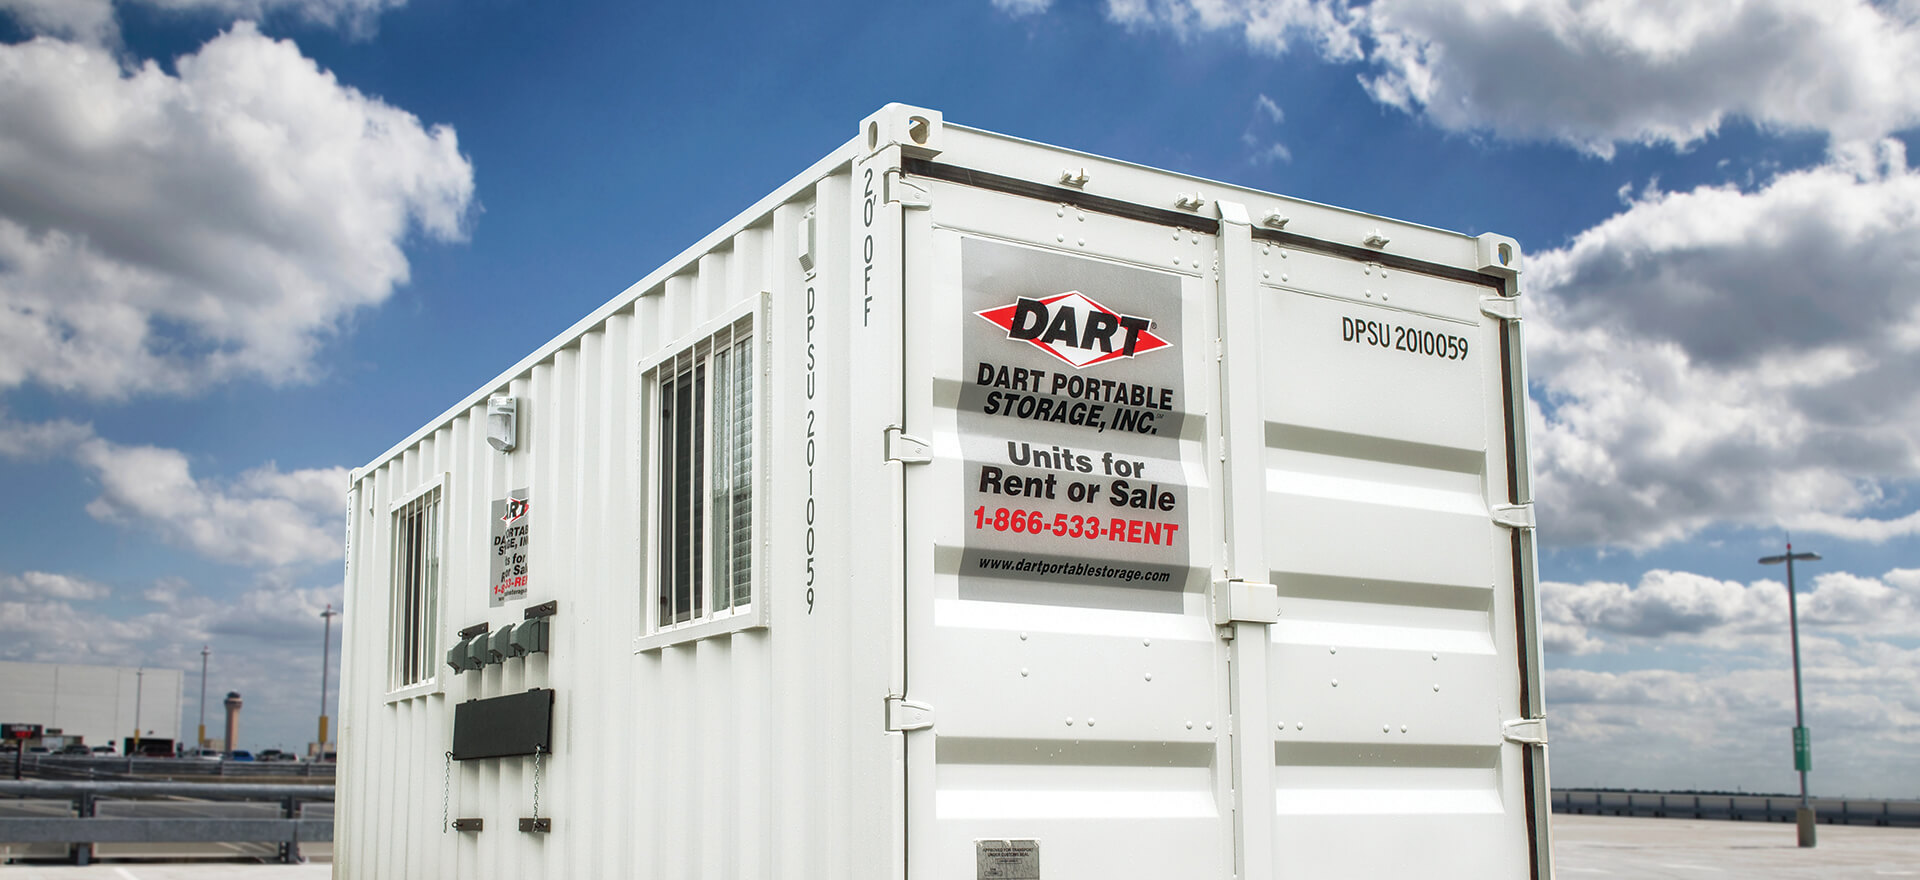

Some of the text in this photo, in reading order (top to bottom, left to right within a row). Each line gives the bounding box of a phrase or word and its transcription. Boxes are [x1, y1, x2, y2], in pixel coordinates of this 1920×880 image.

[1010, 298, 1150, 357] DART
[1342, 316, 1468, 361] DPSU 2010059
[976, 362, 1174, 411] DART PORTABLE
[983, 390, 1158, 436] STORAGE, INC.
[806, 287, 816, 615] DPSU 2010059
[1007, 441, 1145, 479] Units for
[978, 465, 1176, 512] Rent or Sale
[973, 505, 1179, 546] 1-866-533-RENT
[512, 553, 526, 564] for
[513, 563, 528, 576] Sal
[979, 557, 1171, 583] www.dartportablestorage.com
